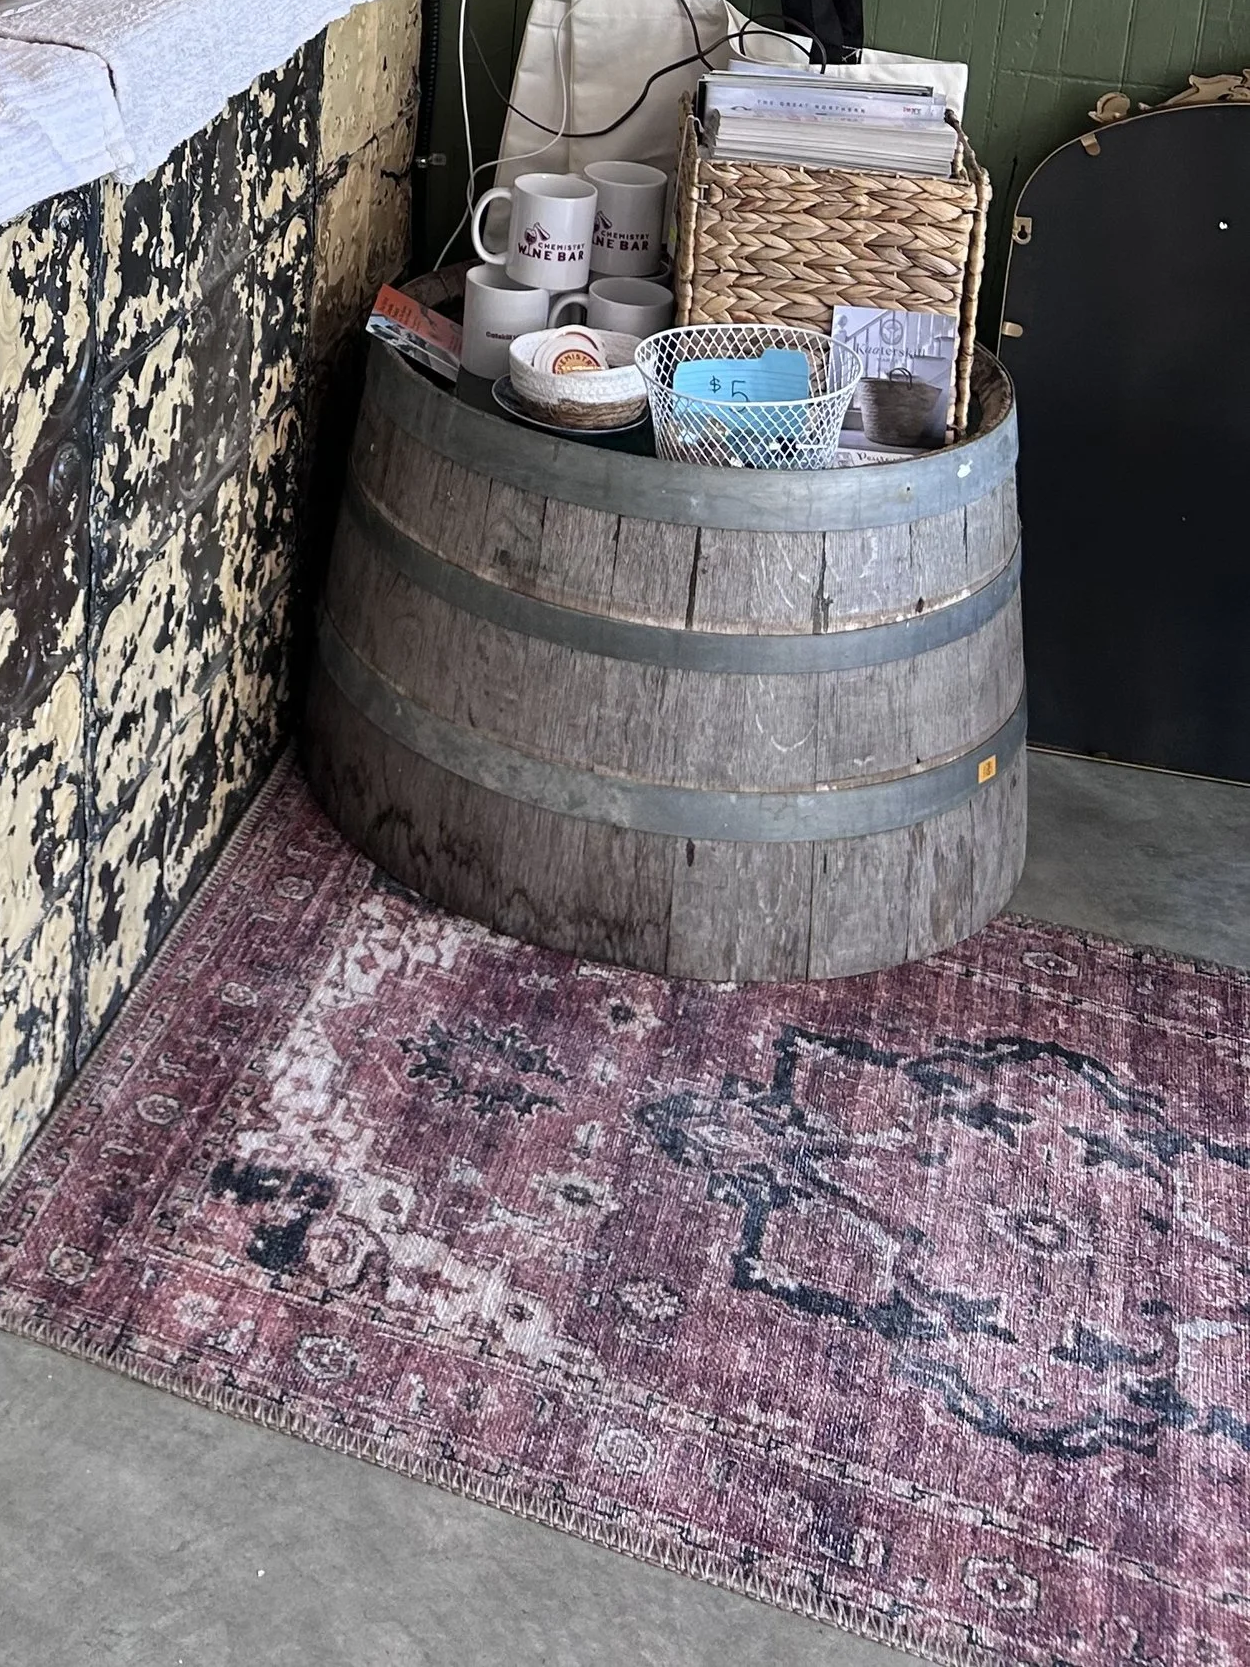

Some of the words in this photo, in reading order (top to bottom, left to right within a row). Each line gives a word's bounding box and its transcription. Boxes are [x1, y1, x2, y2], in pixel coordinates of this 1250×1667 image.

[815, 104, 866, 114] NORTHERN
[601, 229, 650, 240] CHEMISTRY
[537, 242, 585, 251] CHEMISTRY
[619, 240, 649, 251] BAR
[518, 242, 551, 261] WINE
[558, 251, 584, 262] BAR
